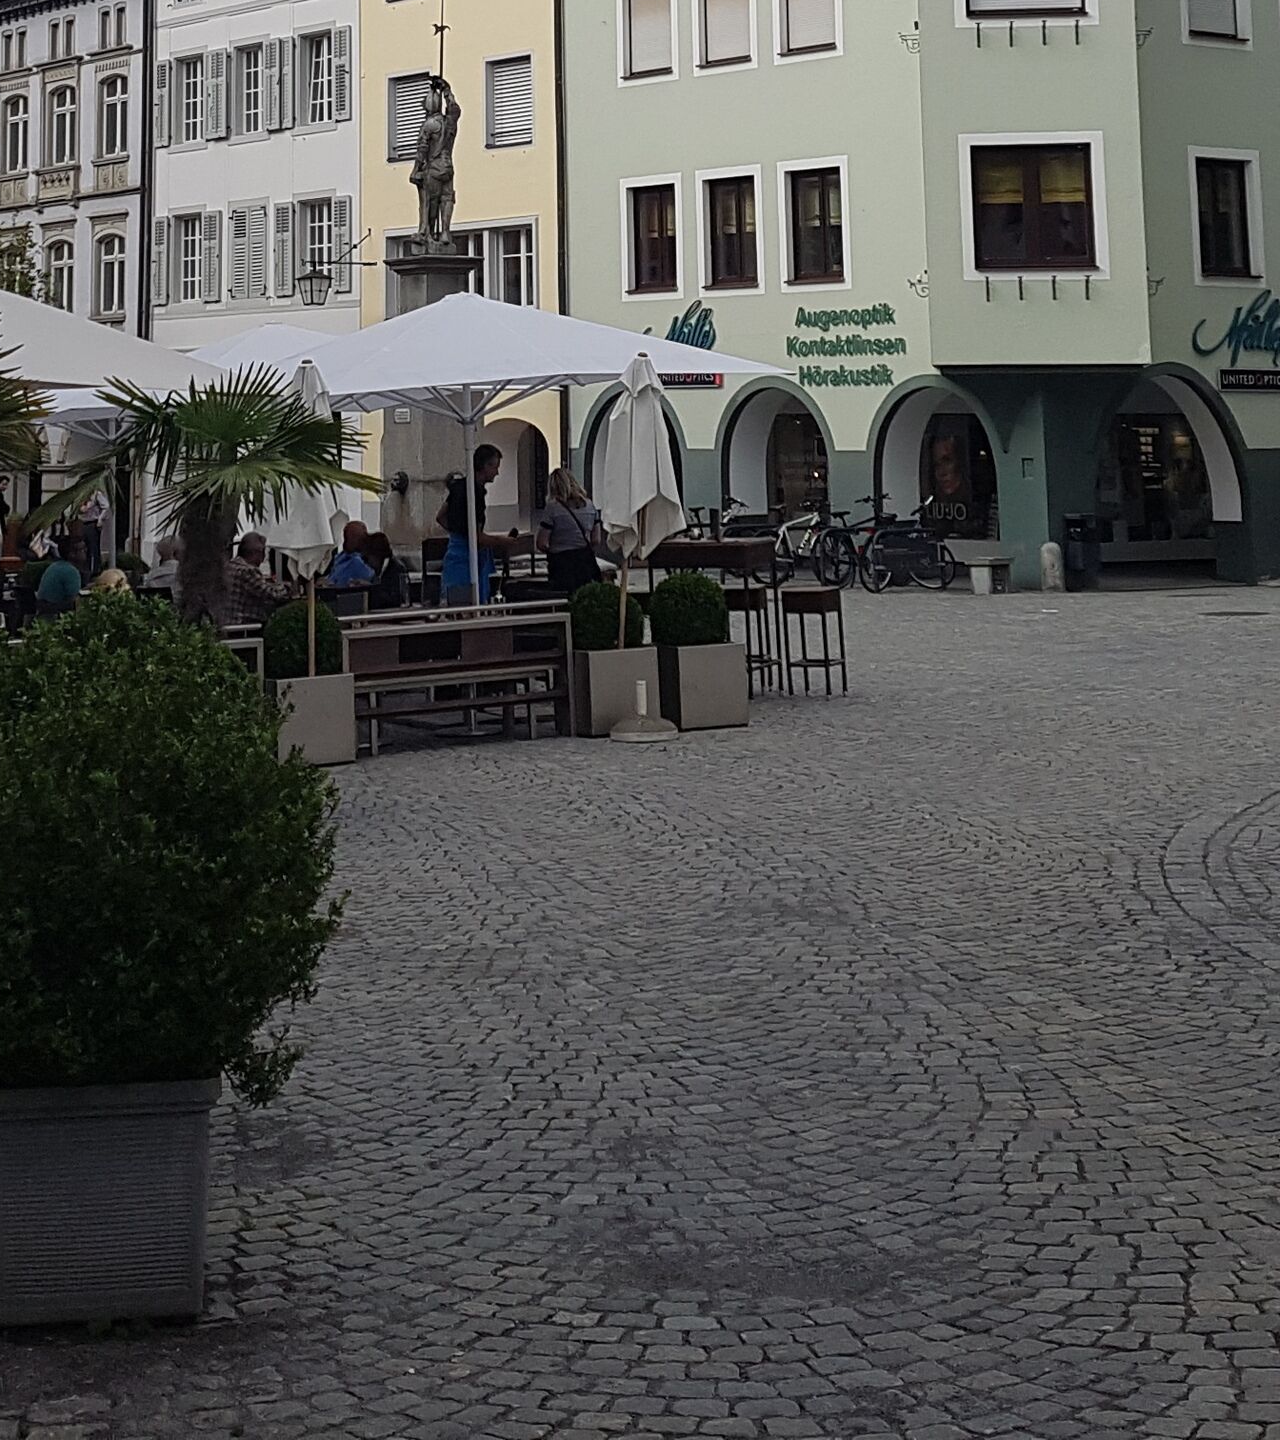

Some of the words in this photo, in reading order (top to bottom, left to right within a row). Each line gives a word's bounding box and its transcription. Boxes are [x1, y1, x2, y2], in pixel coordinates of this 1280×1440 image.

[795, 302, 896, 332] Augenoptik
[786, 335, 907, 358] Kontaktlinsen
[798, 363, 895, 388] Hörakustik
